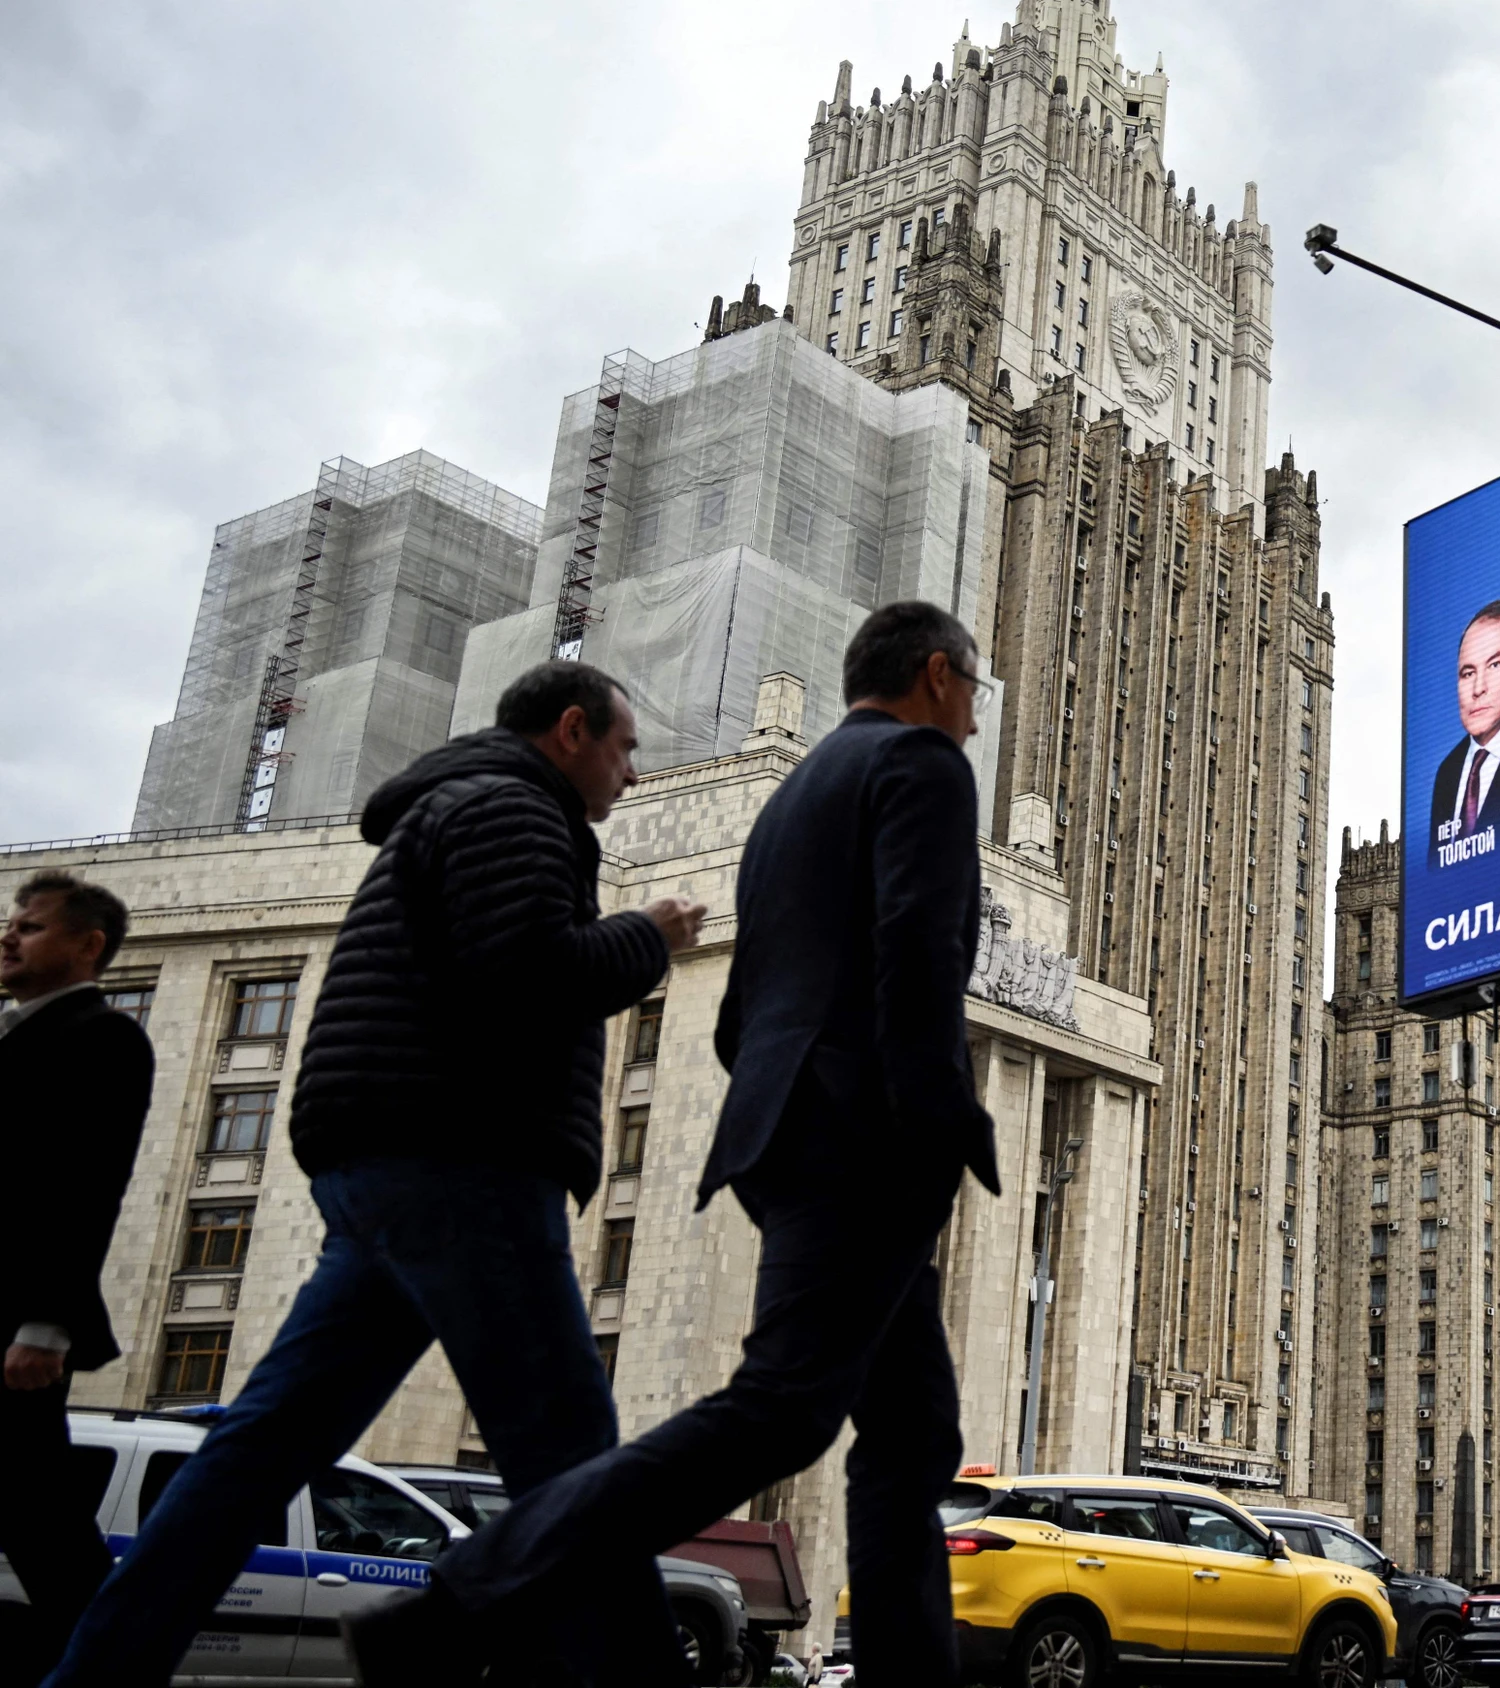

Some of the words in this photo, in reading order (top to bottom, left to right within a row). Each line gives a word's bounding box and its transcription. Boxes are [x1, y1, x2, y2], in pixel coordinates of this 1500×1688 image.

[1438, 819, 1462, 841] ПЁТР
[1437, 825, 1495, 868] ТОЛСТОЙ
[220, 1598, 253, 1607] оскве
